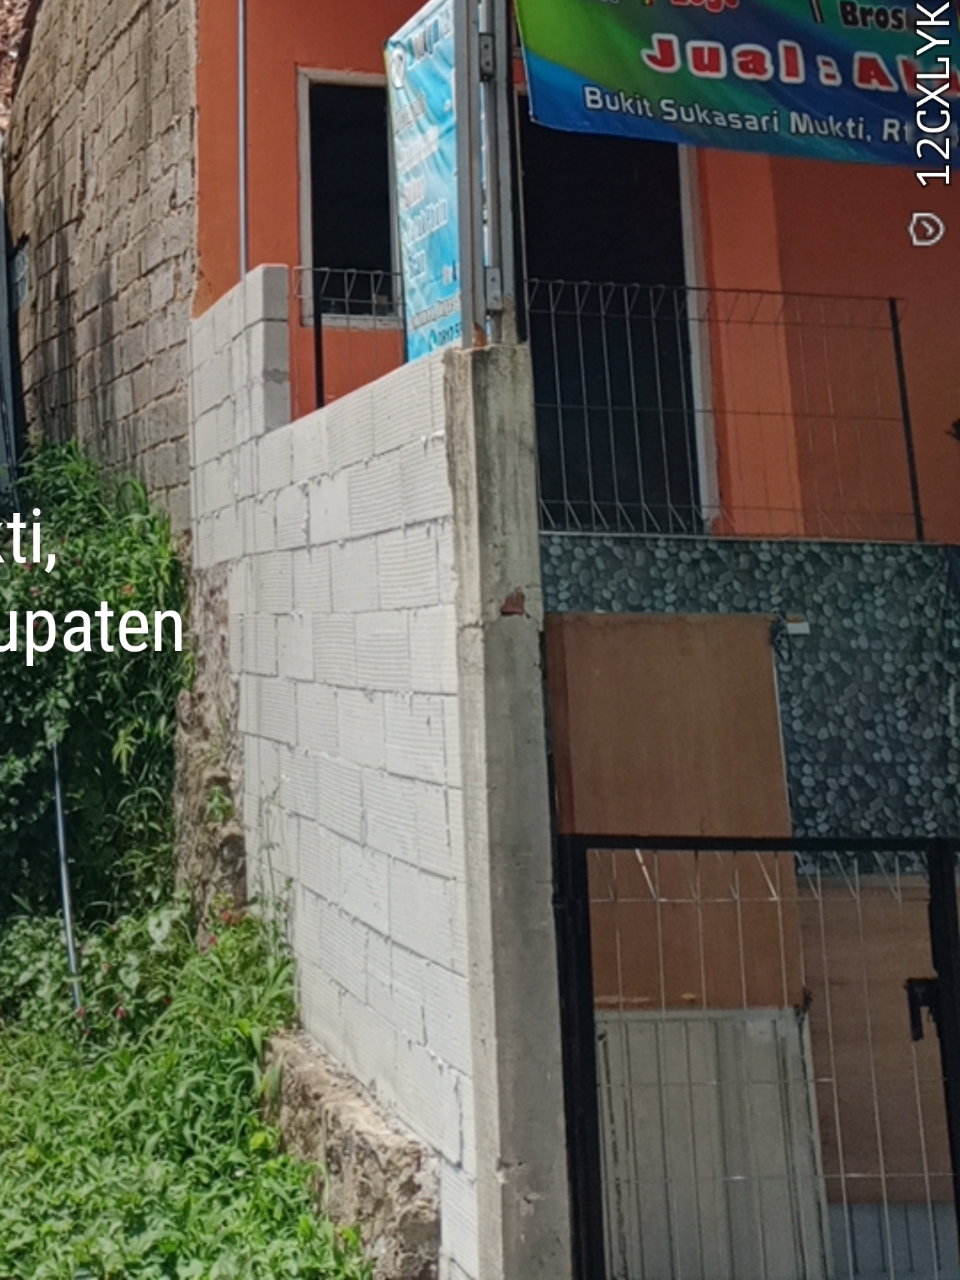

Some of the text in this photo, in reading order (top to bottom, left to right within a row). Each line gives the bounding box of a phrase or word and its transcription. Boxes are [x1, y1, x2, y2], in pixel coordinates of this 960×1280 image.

[583, 85, 654, 118] Bukit
[659, 98, 780, 134] Sukasari
[790, 110, 872, 142] Mukti,
